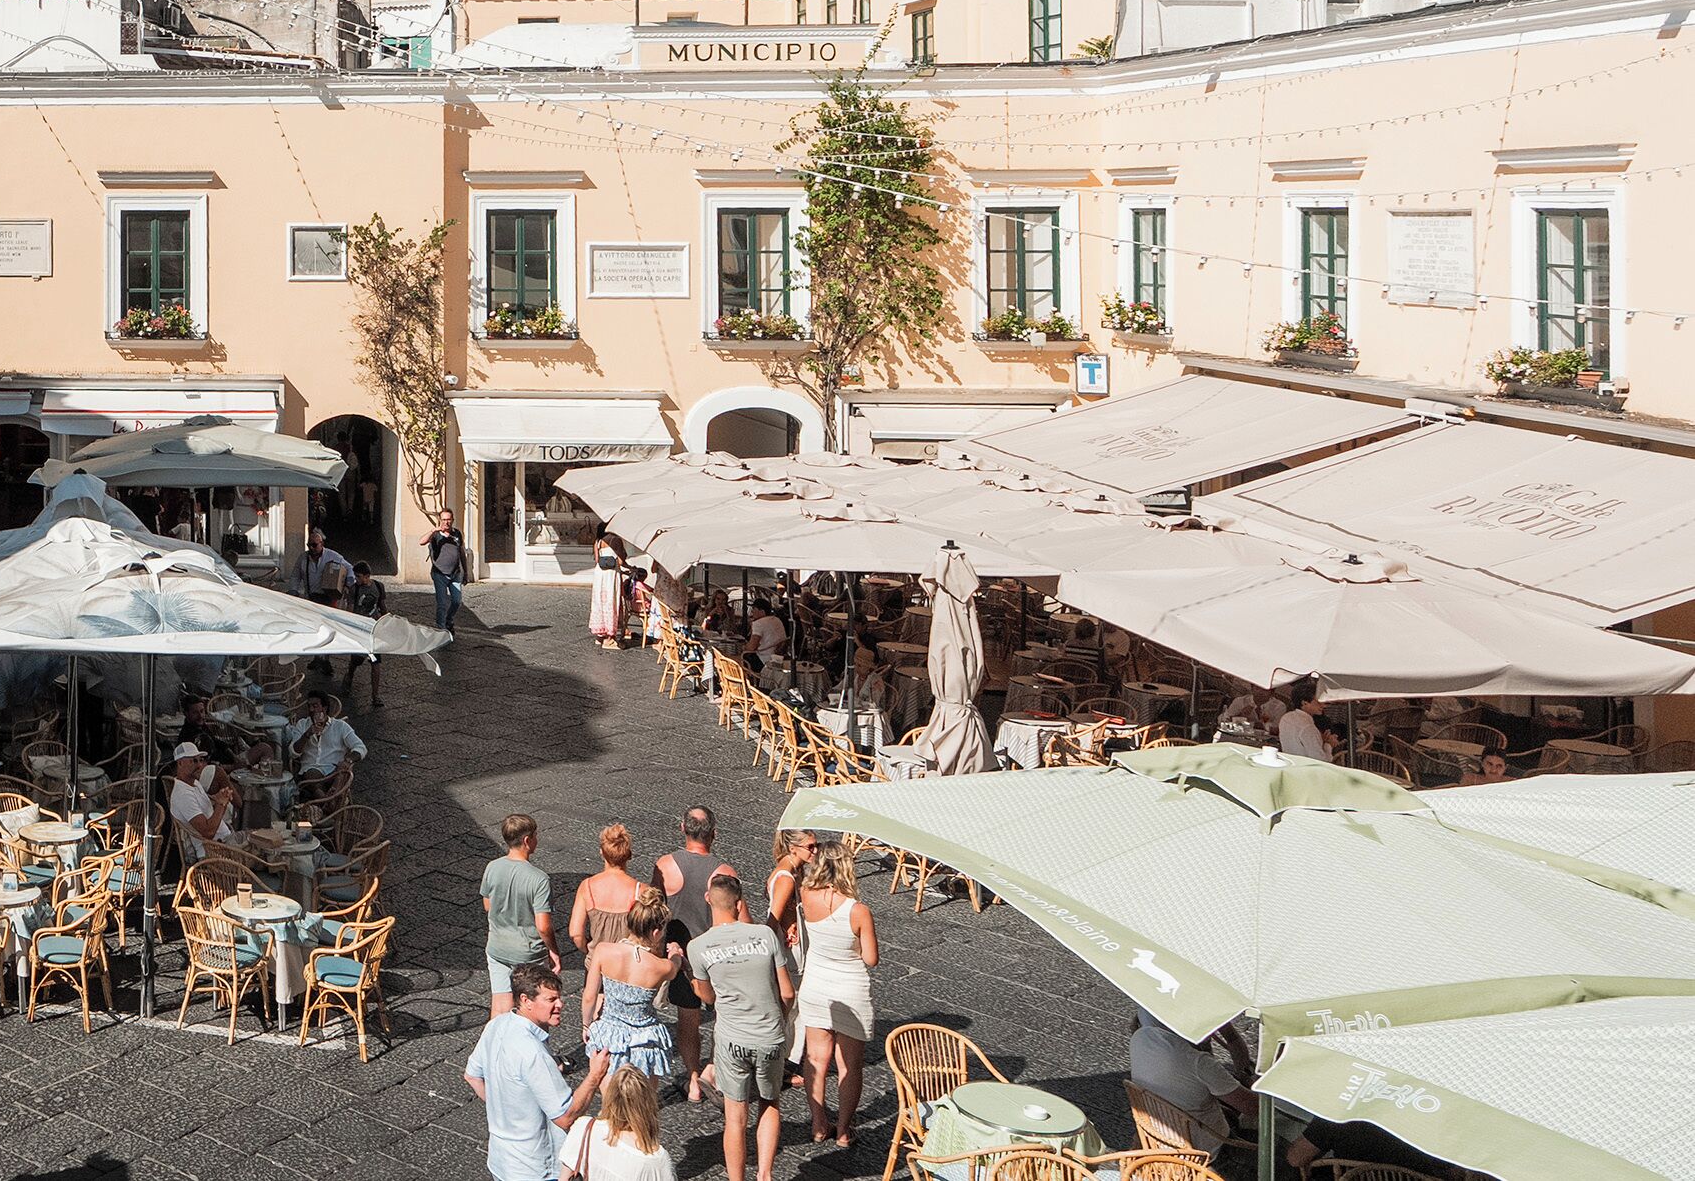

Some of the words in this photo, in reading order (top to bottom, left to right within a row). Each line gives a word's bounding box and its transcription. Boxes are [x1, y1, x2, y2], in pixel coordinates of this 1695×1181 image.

[667, 42, 837, 62] MUNICIPIO
[1554, 490, 1627, 519] Caffè
[1338, 1074, 1365, 1103] BAR
